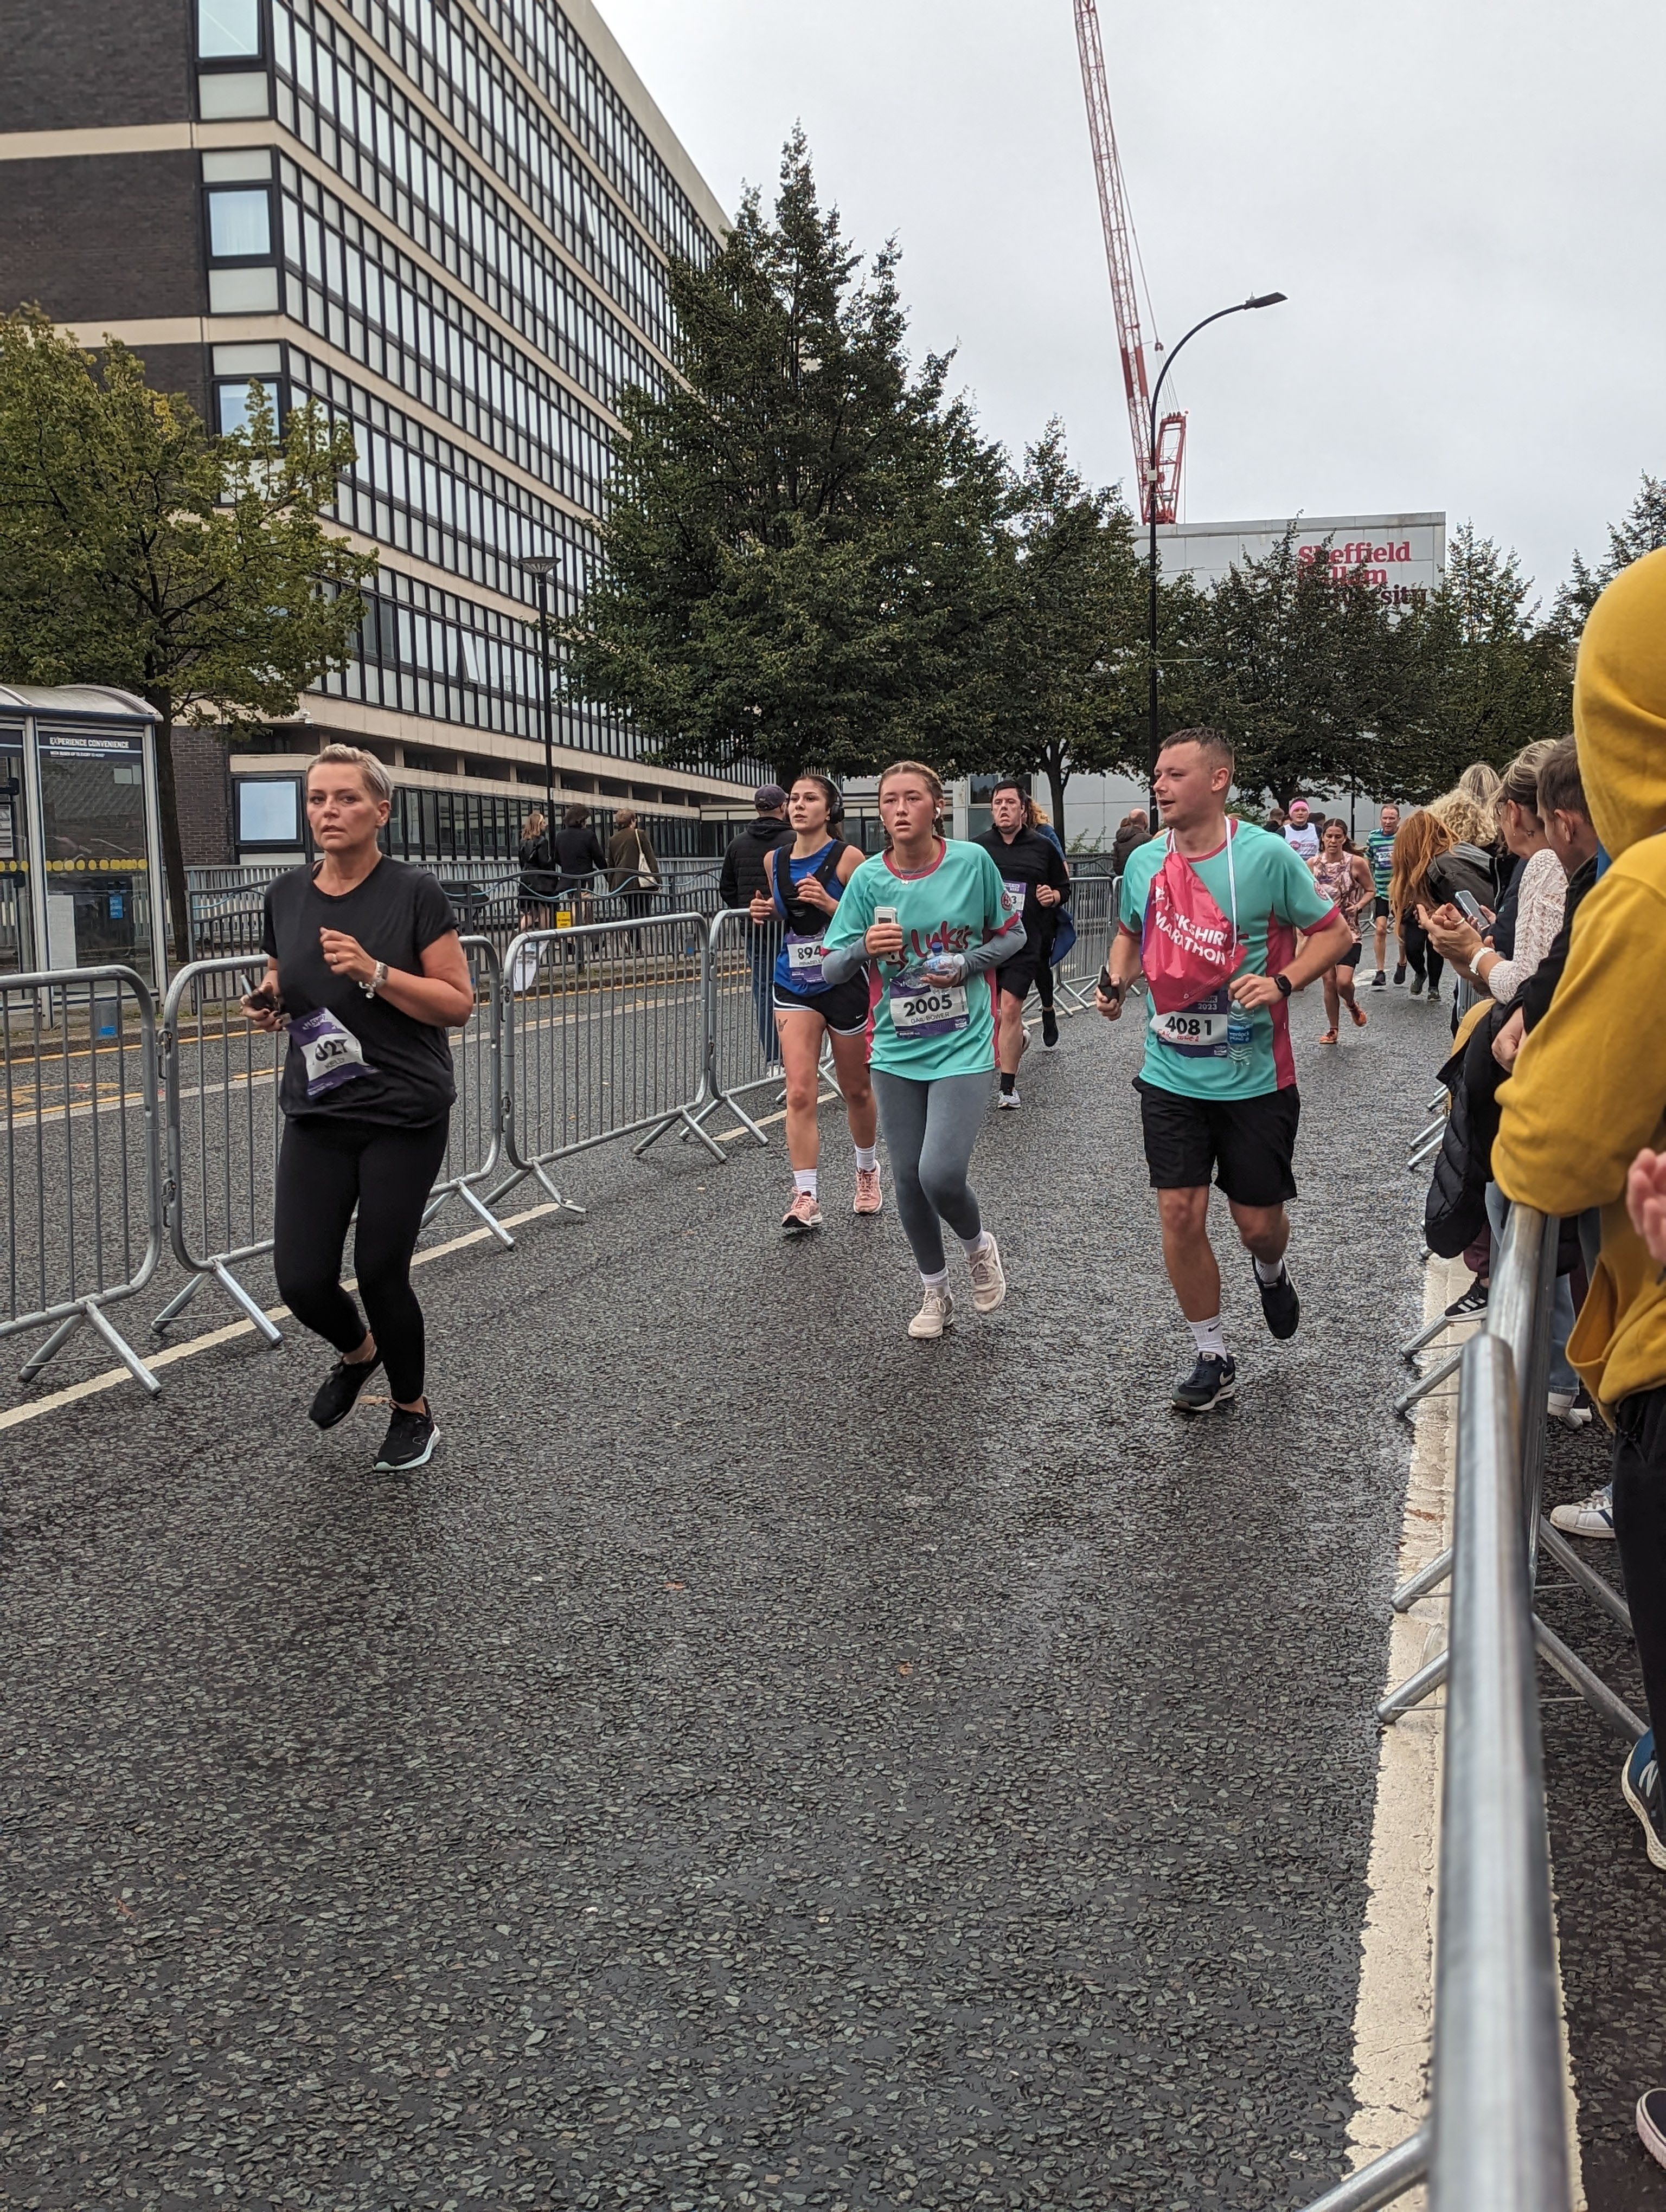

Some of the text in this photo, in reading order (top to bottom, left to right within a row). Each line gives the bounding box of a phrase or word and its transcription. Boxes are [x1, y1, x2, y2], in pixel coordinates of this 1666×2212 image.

[1298, 541, 1411, 565] Seffield
[49, 737, 130, 748] EXPERIENCE CONVENIENCE
[904, 994, 952, 1017] 2005
[1165, 1016, 1212, 1035] 4081
